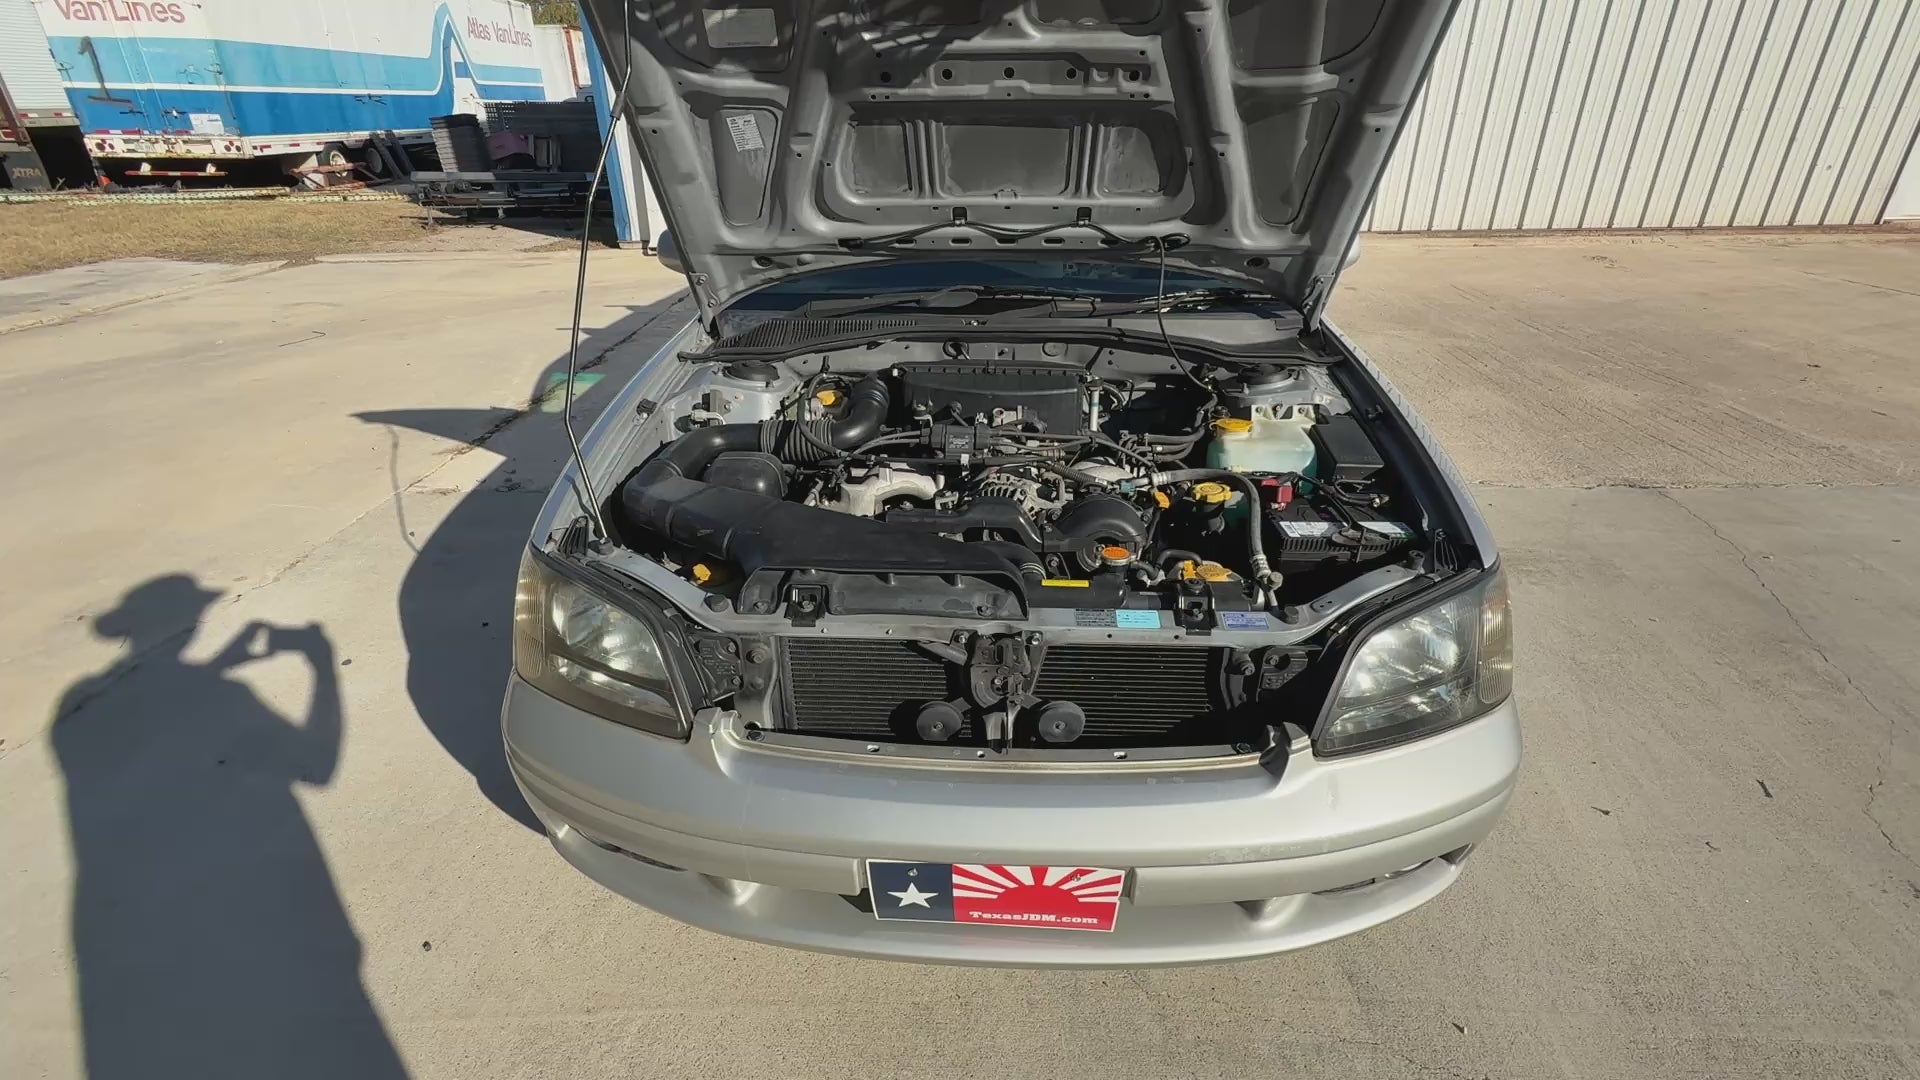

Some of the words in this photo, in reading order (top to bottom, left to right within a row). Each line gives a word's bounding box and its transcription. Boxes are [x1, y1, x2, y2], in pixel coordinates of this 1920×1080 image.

[53, 0, 108, 20] Van
[108, 0, 186, 23] Lines
[467, 16, 491, 41] Atlas
[969, 911, 1098, 924] TexasJDM.com
